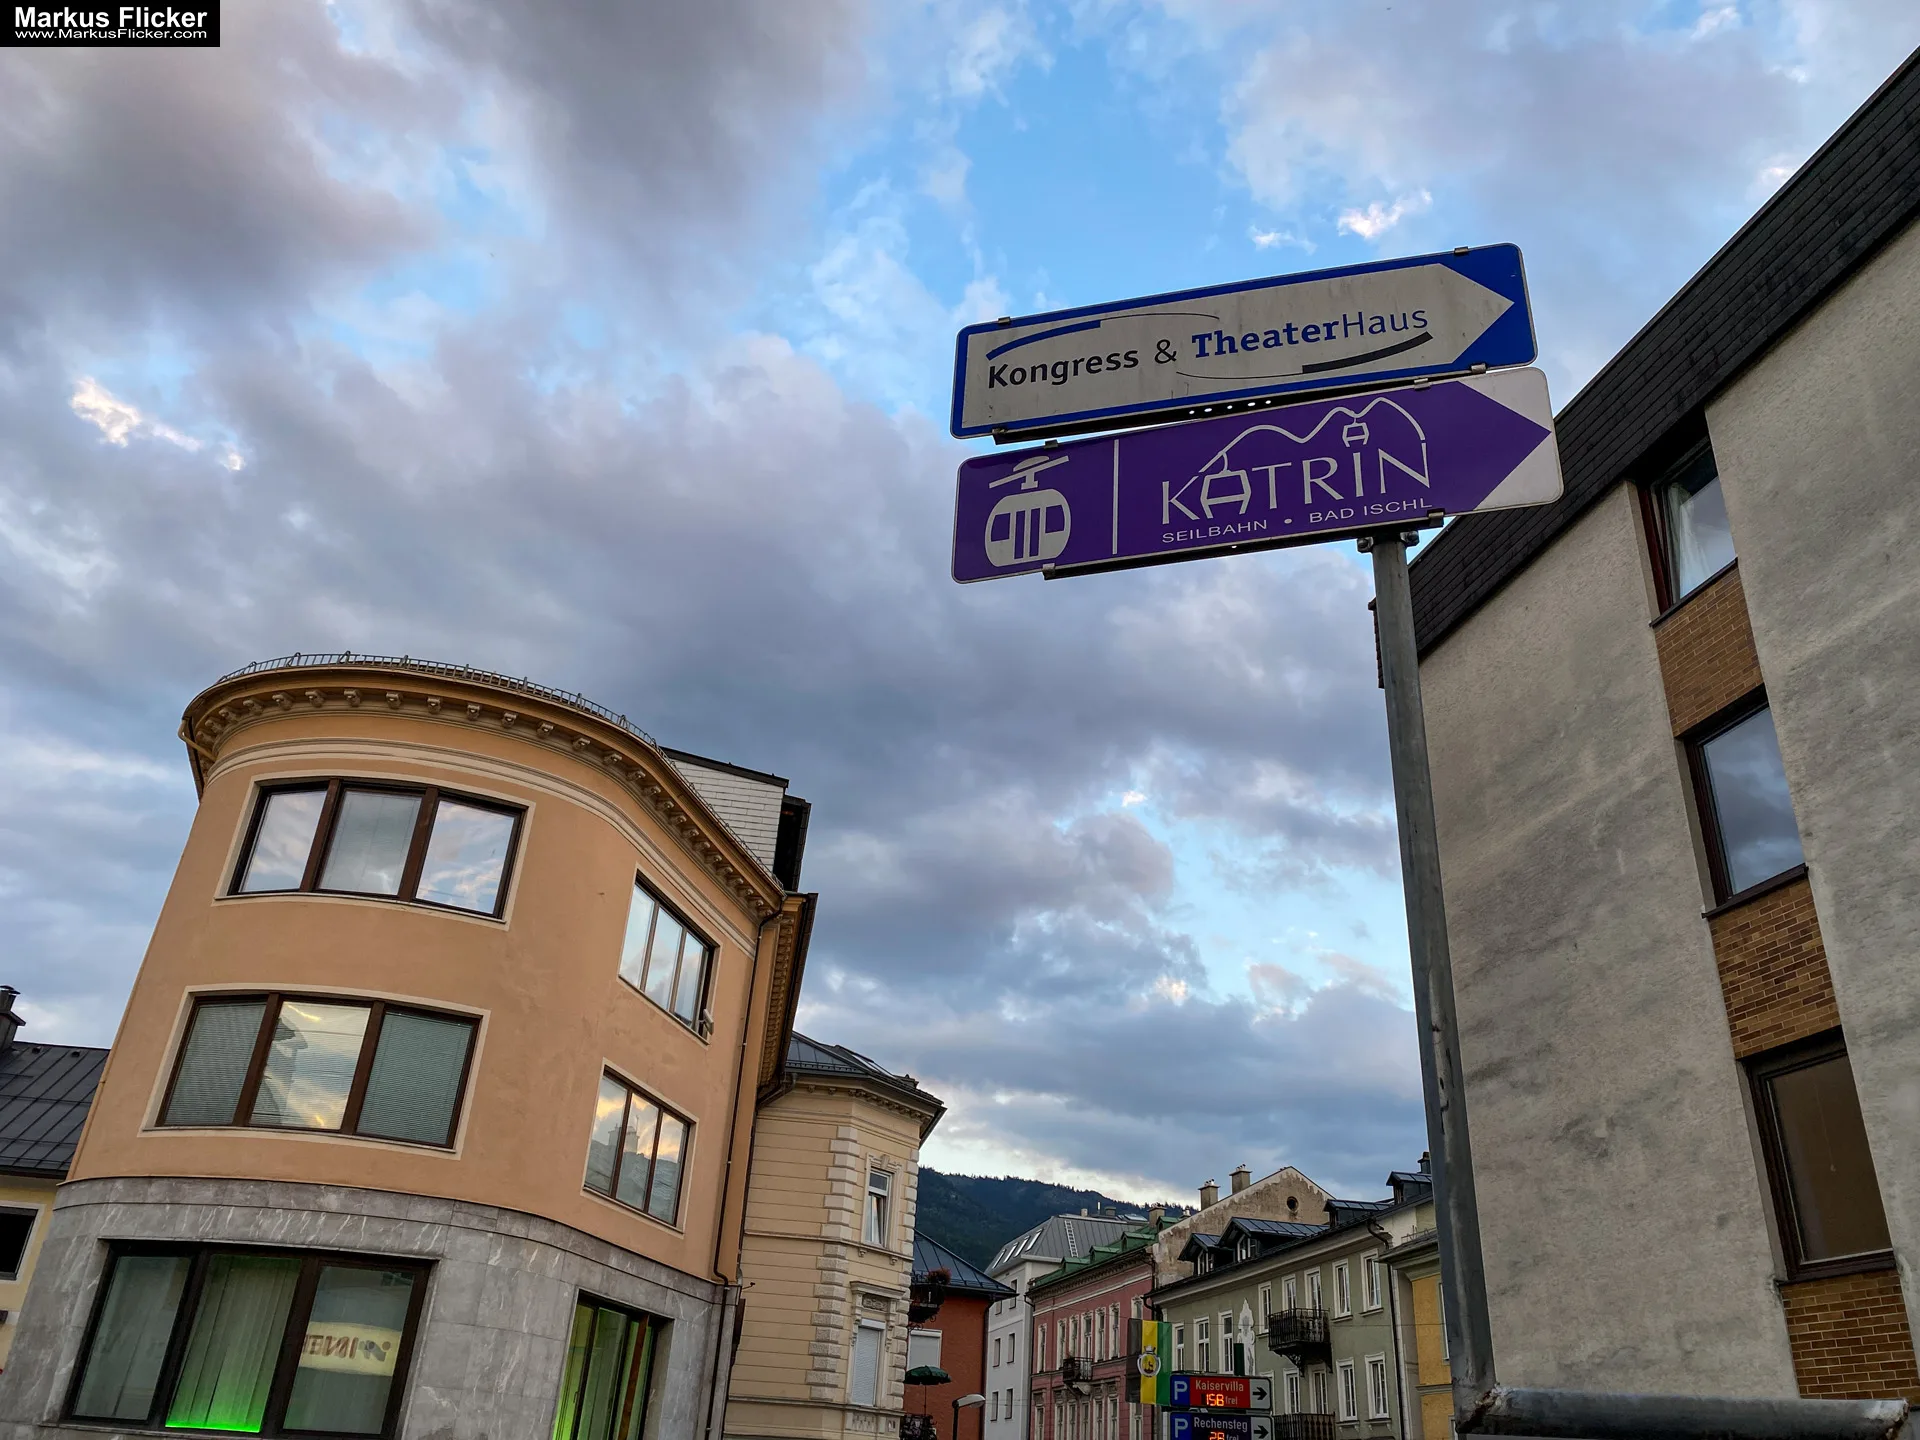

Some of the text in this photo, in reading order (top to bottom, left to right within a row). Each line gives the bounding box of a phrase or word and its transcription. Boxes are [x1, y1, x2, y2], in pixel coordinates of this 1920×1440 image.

[987, 308, 1429, 390] Kongress & TheaterHaus
[1161, 441, 1430, 526] KATRIN
[1162, 497, 1433, 544] SEILBAHN BAD ISCHL
[1174, 1379, 1245, 1401] P Kaiservilla
[1206, 1393, 1238, 1407] 158 frei
[1174, 1416, 1248, 1438] P Rechensteg
